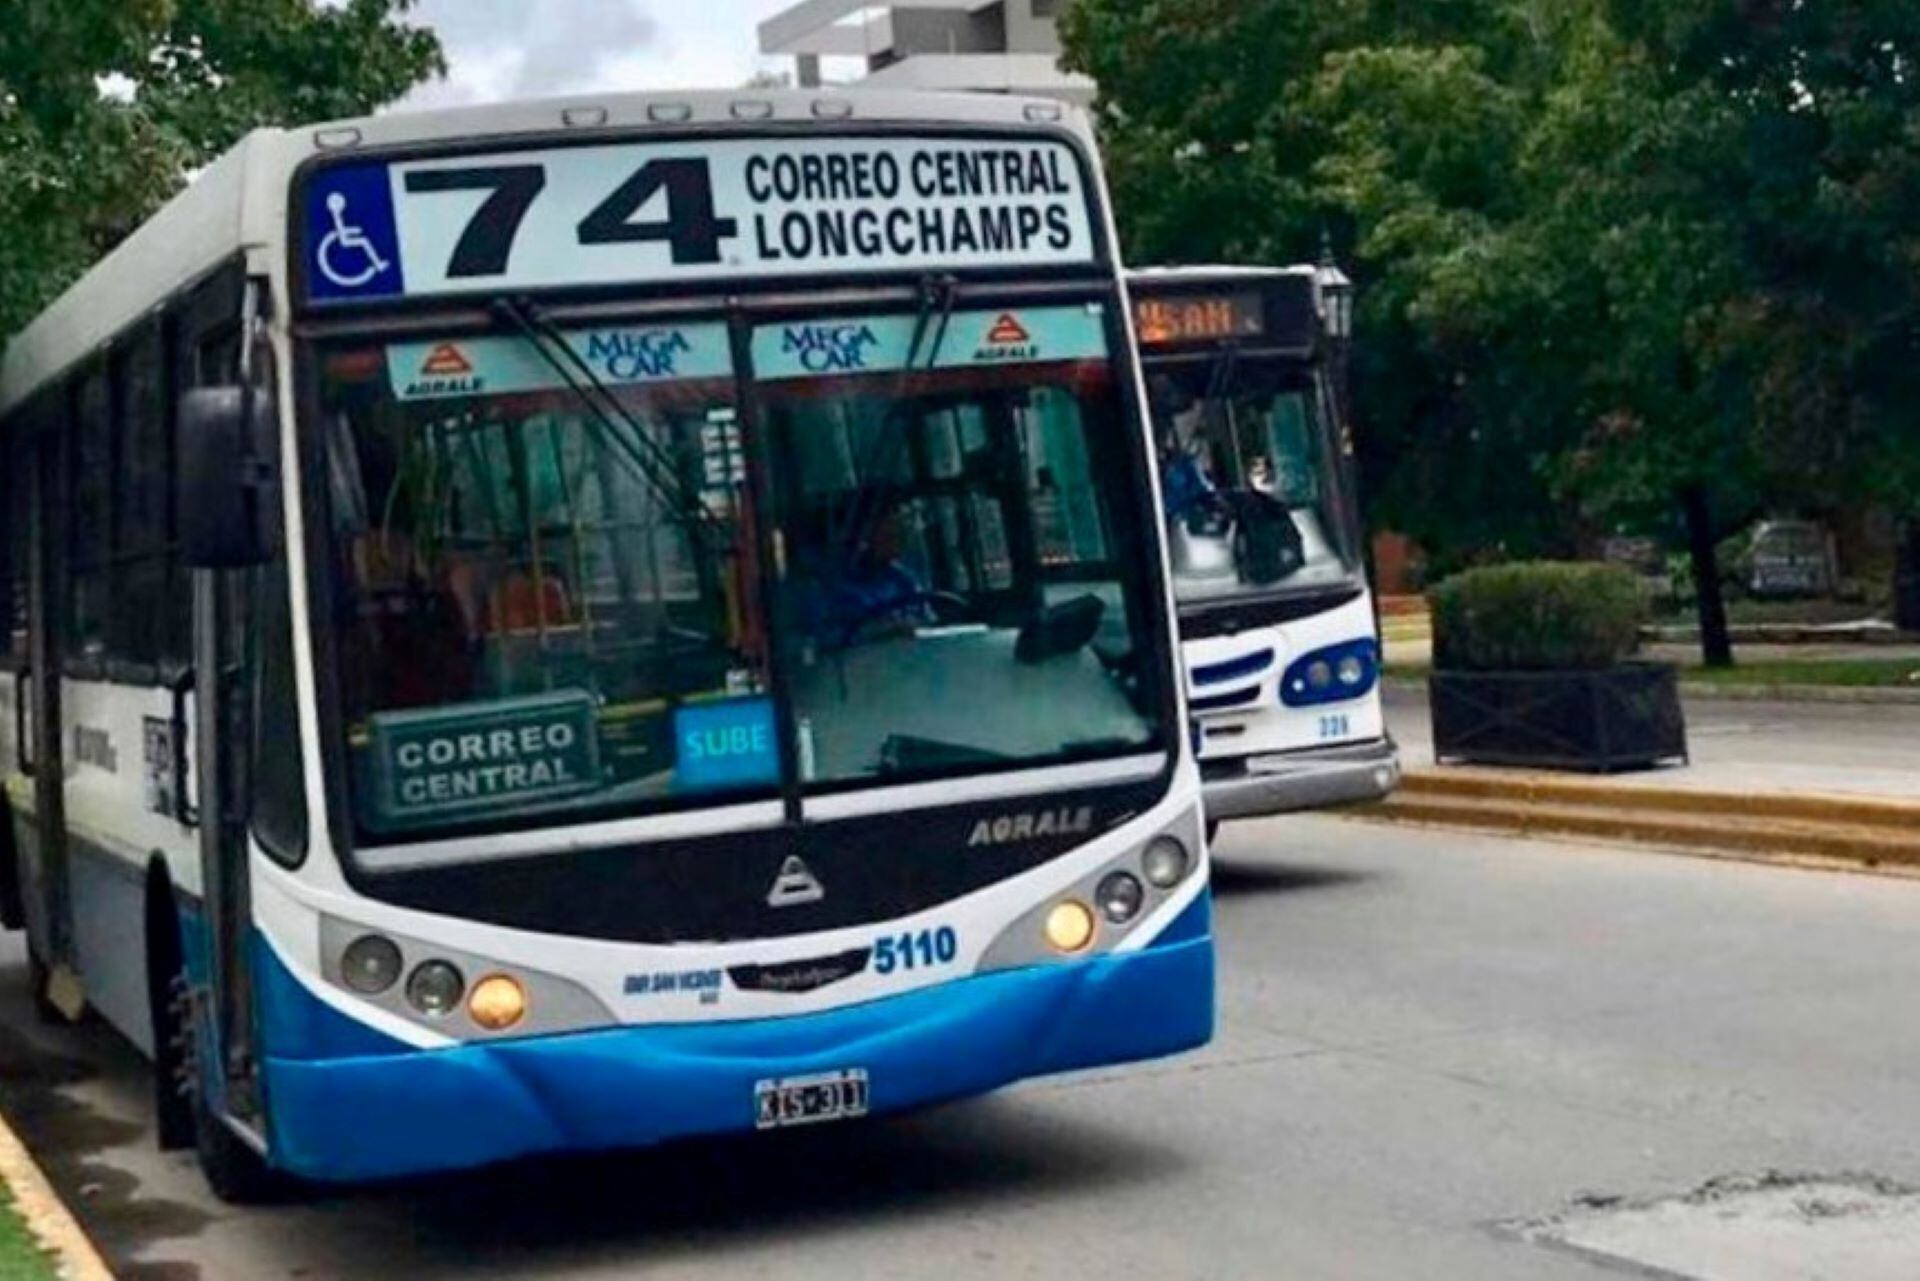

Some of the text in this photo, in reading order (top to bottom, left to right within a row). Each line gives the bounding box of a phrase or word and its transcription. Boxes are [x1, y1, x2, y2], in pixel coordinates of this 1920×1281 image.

[745, 148, 1070, 202] CORREO CENTRAL
[403, 156, 737, 279] 74
[754, 203, 1072, 259] LONGCHAMPS
[587, 331, 689, 360] MEGA
[780, 322, 878, 352] MEGA
[607, 352, 677, 379] CAR
[799, 346, 873, 373] CAR
[399, 723, 573, 767] CORREO
[684, 724, 769, 759] SUBE
[402, 759, 574, 801] CENTRAL
[968, 806, 1093, 847] AGRALE
[874, 926, 956, 974] 5110
